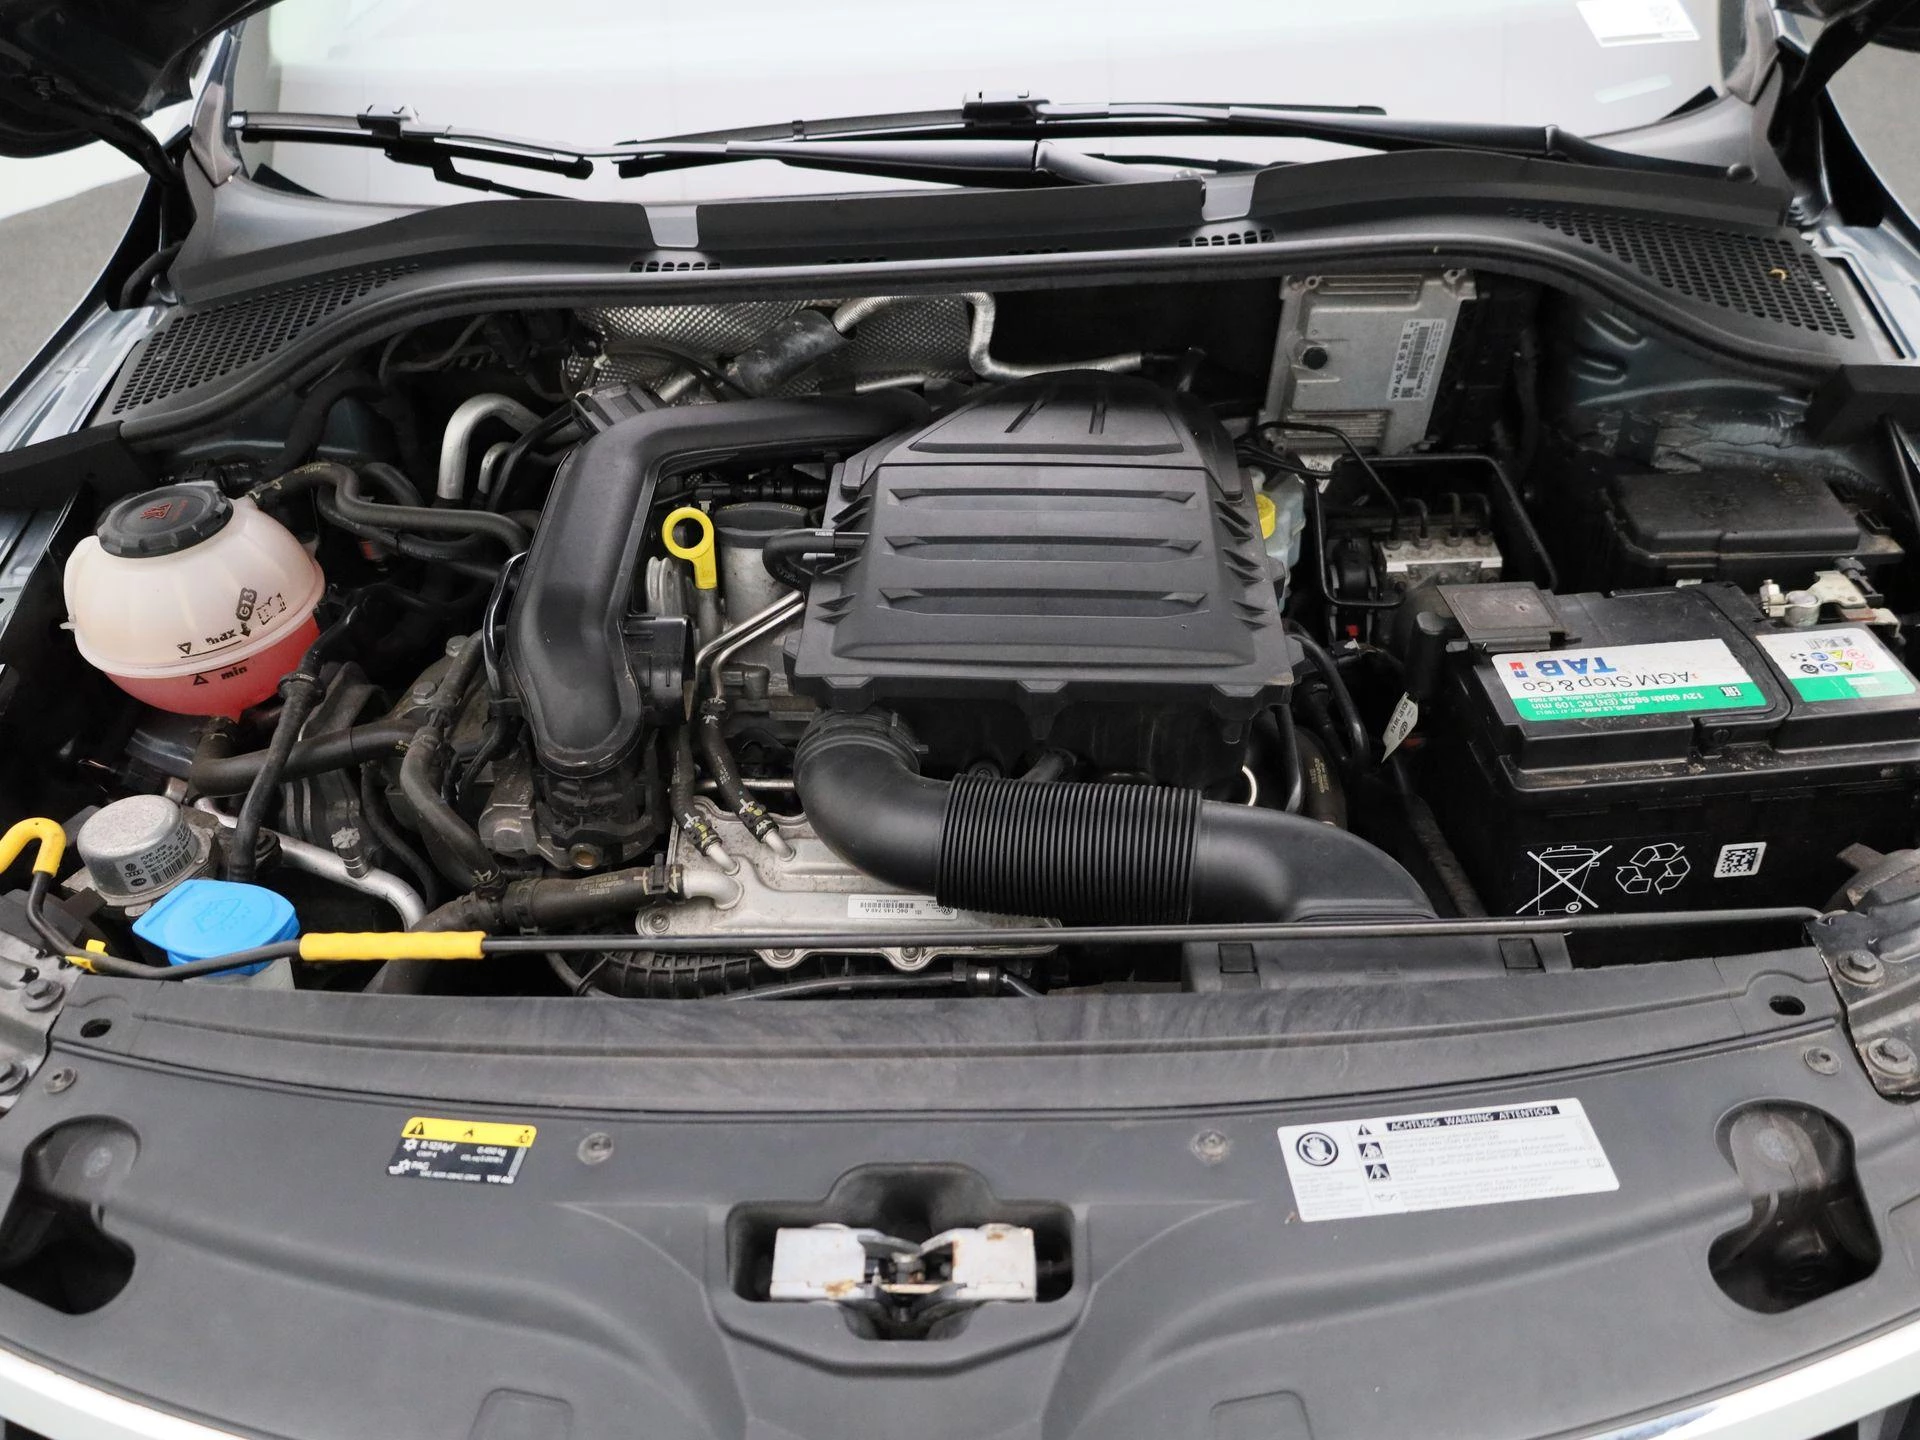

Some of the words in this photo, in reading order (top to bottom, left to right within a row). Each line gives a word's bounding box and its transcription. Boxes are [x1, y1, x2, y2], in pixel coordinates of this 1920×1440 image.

[241, 589, 256, 618] G13
[220, 665, 248, 680] min
[1535, 656, 1617, 677] TAB
[1578, 675, 1633, 688] Stop
[1634, 671, 1689, 687] AGM
[1522, 681, 1554, 693] Go
[1650, 693, 1681, 703] 60Ah
[1682, 692, 1705, 700] 12V
[1554, 701, 1576, 709] 109
[1389, 1117, 1441, 1132] ACHTUNG
[1444, 1112, 1494, 1127] WARNING
[1498, 1106, 1553, 1121] ATTENTION
